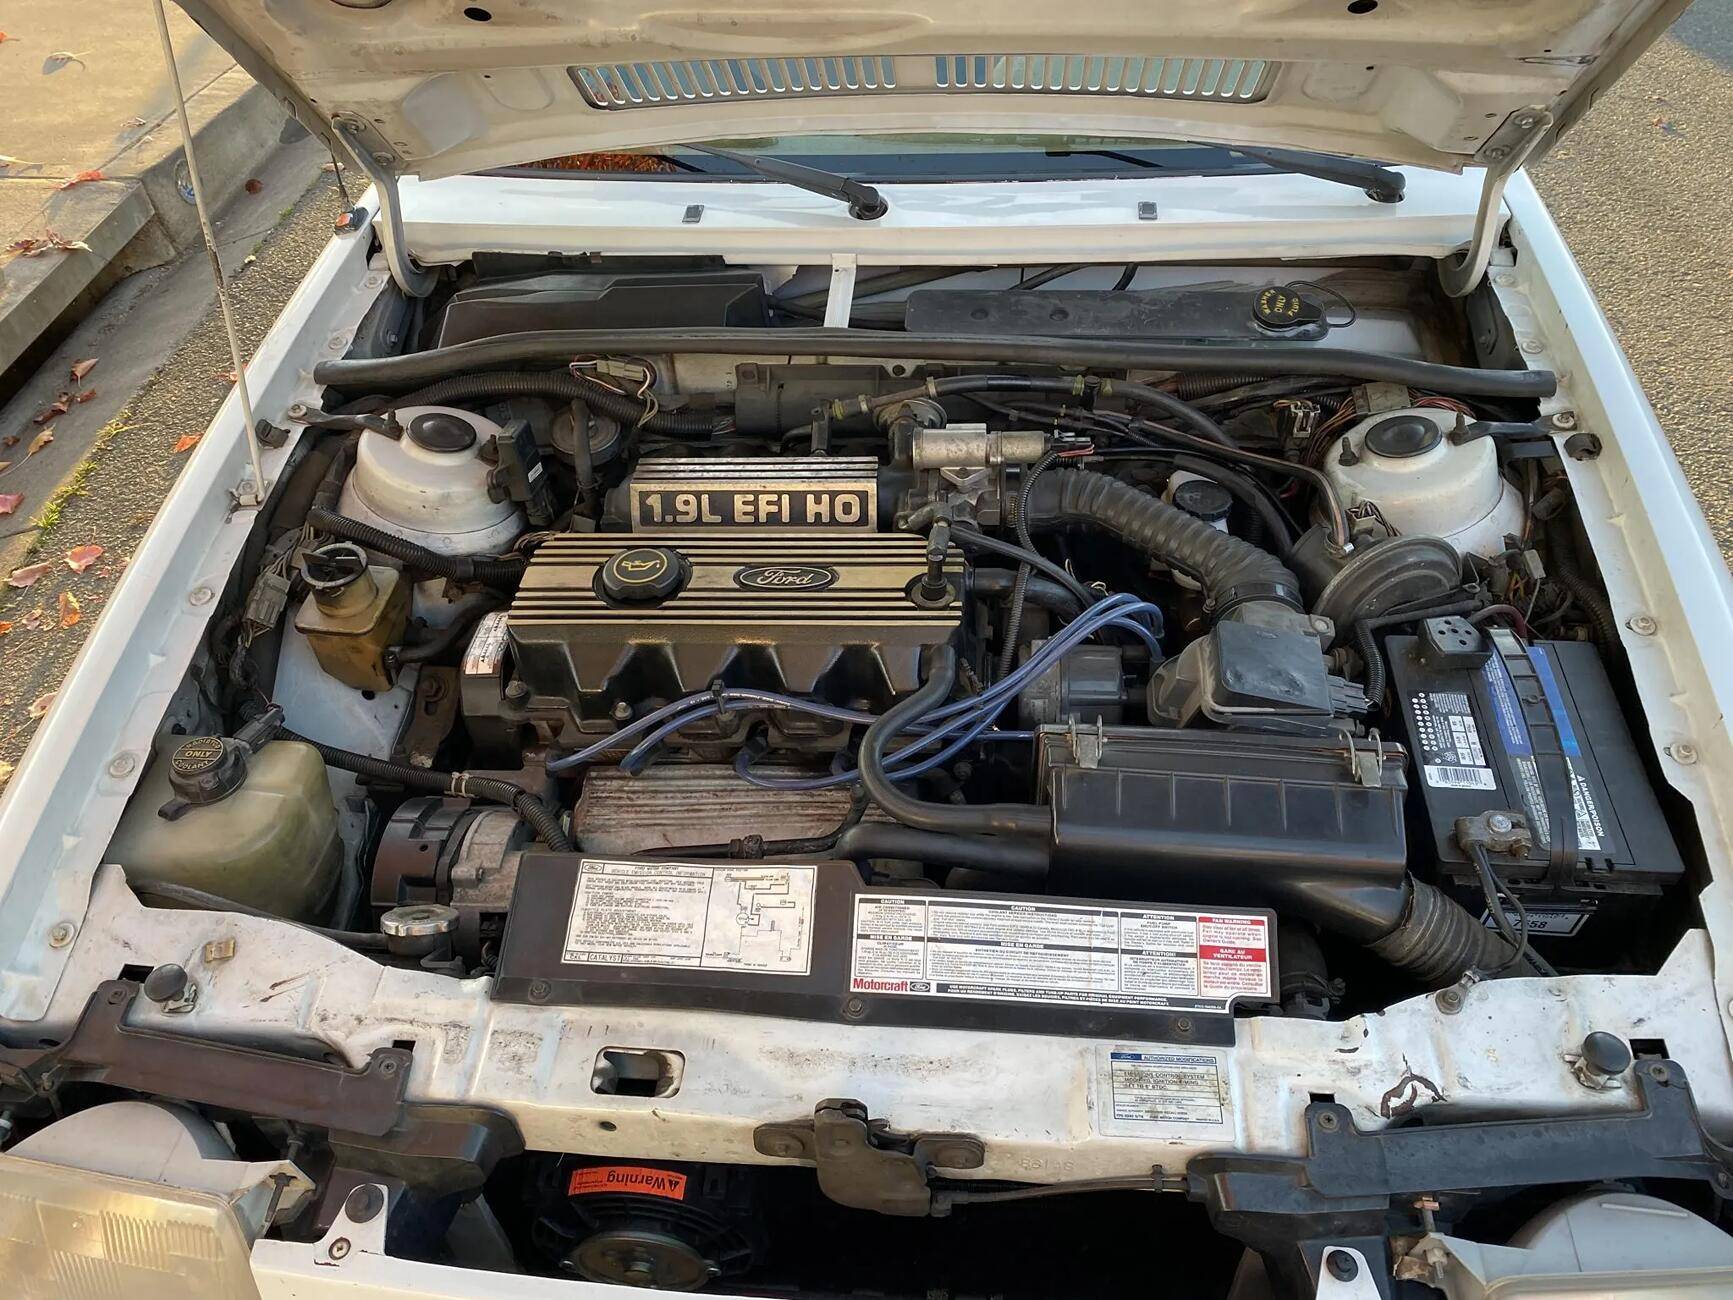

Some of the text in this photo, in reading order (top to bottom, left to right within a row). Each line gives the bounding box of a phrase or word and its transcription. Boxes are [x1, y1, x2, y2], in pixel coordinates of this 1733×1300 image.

[1274, 294, 1286, 312] ONLY
[1288, 298, 1299, 317] FLUID
[645, 493, 861, 523] 1.9L EFI HO
[756, 568, 815, 586] Ford
[1513, 920, 1548, 929] 758
[589, 952, 620, 962] CATALYST
[852, 978, 909, 992] Motorcraft
[606, 1170, 666, 1190] Warning
